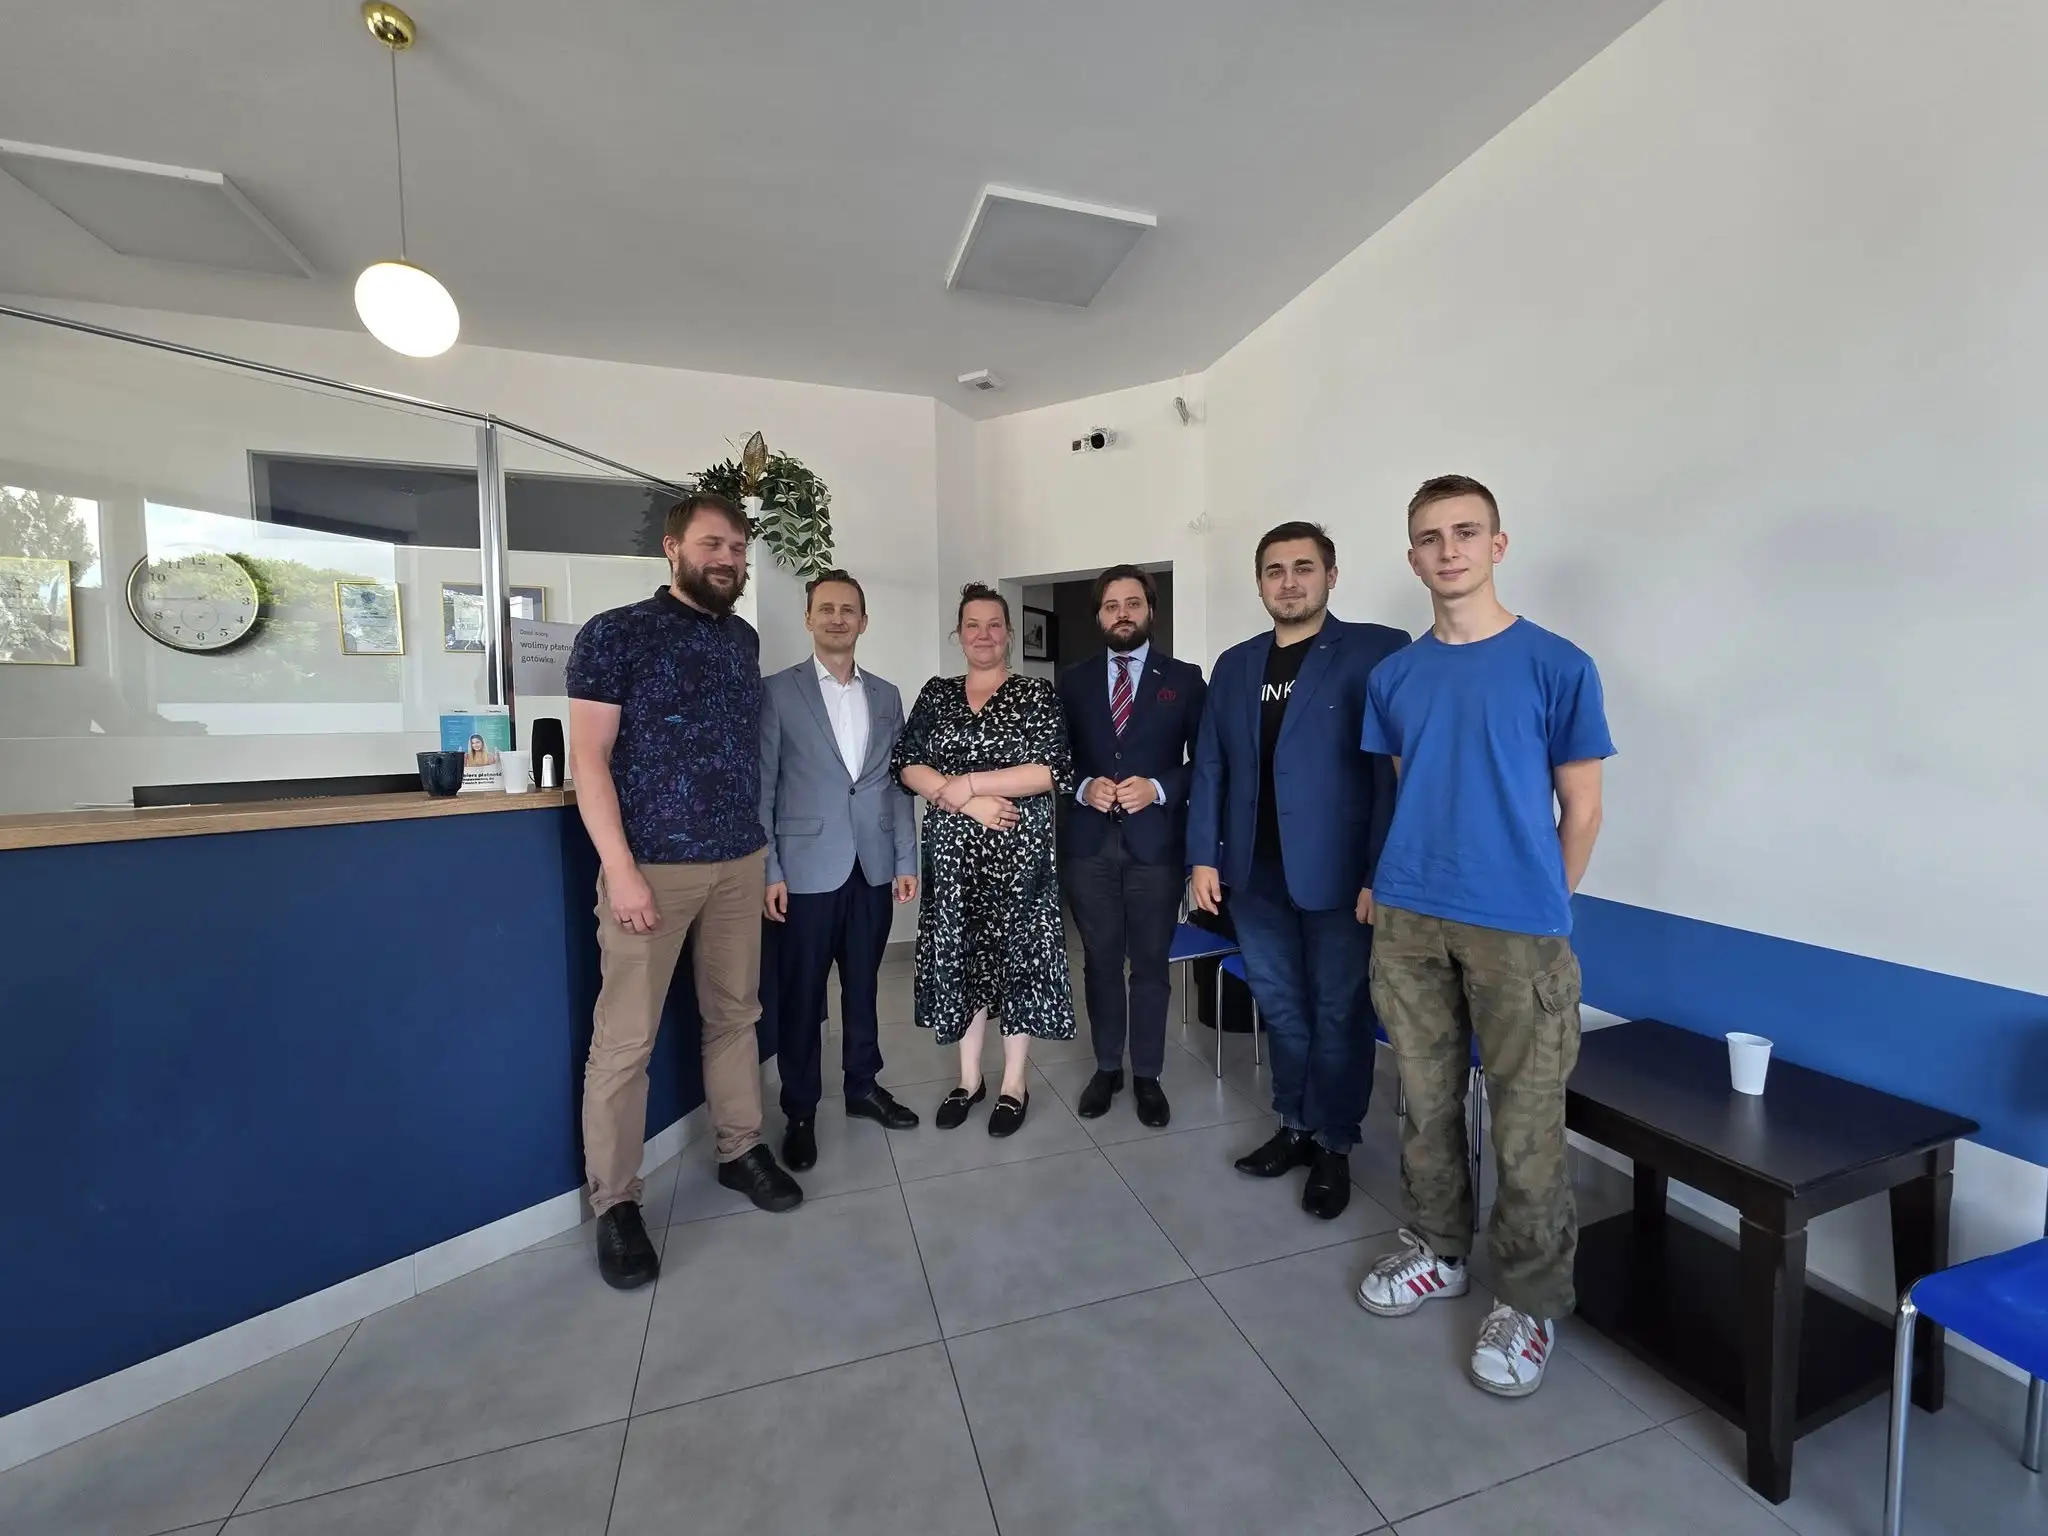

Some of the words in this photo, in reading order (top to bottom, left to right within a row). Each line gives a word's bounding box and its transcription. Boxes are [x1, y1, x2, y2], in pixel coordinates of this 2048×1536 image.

[168, 561, 183, 569] 11
[191, 557, 205, 566] 12
[216, 563, 223, 571] 1
[150, 573, 166, 582] 10
[235, 578, 242, 587] 2
[147, 592, 155, 600] 9
[242, 597, 250, 605] 3
[154, 611, 163, 620] 8
[236, 616, 243, 624] 4
[173, 626, 181, 634] 7
[220, 628, 228, 637] 5
[197, 632, 205, 641] 6
[520, 641, 549, 651] wolimy
[550, 643, 575, 652] płatno
[1262, 680, 1296, 701] INK
